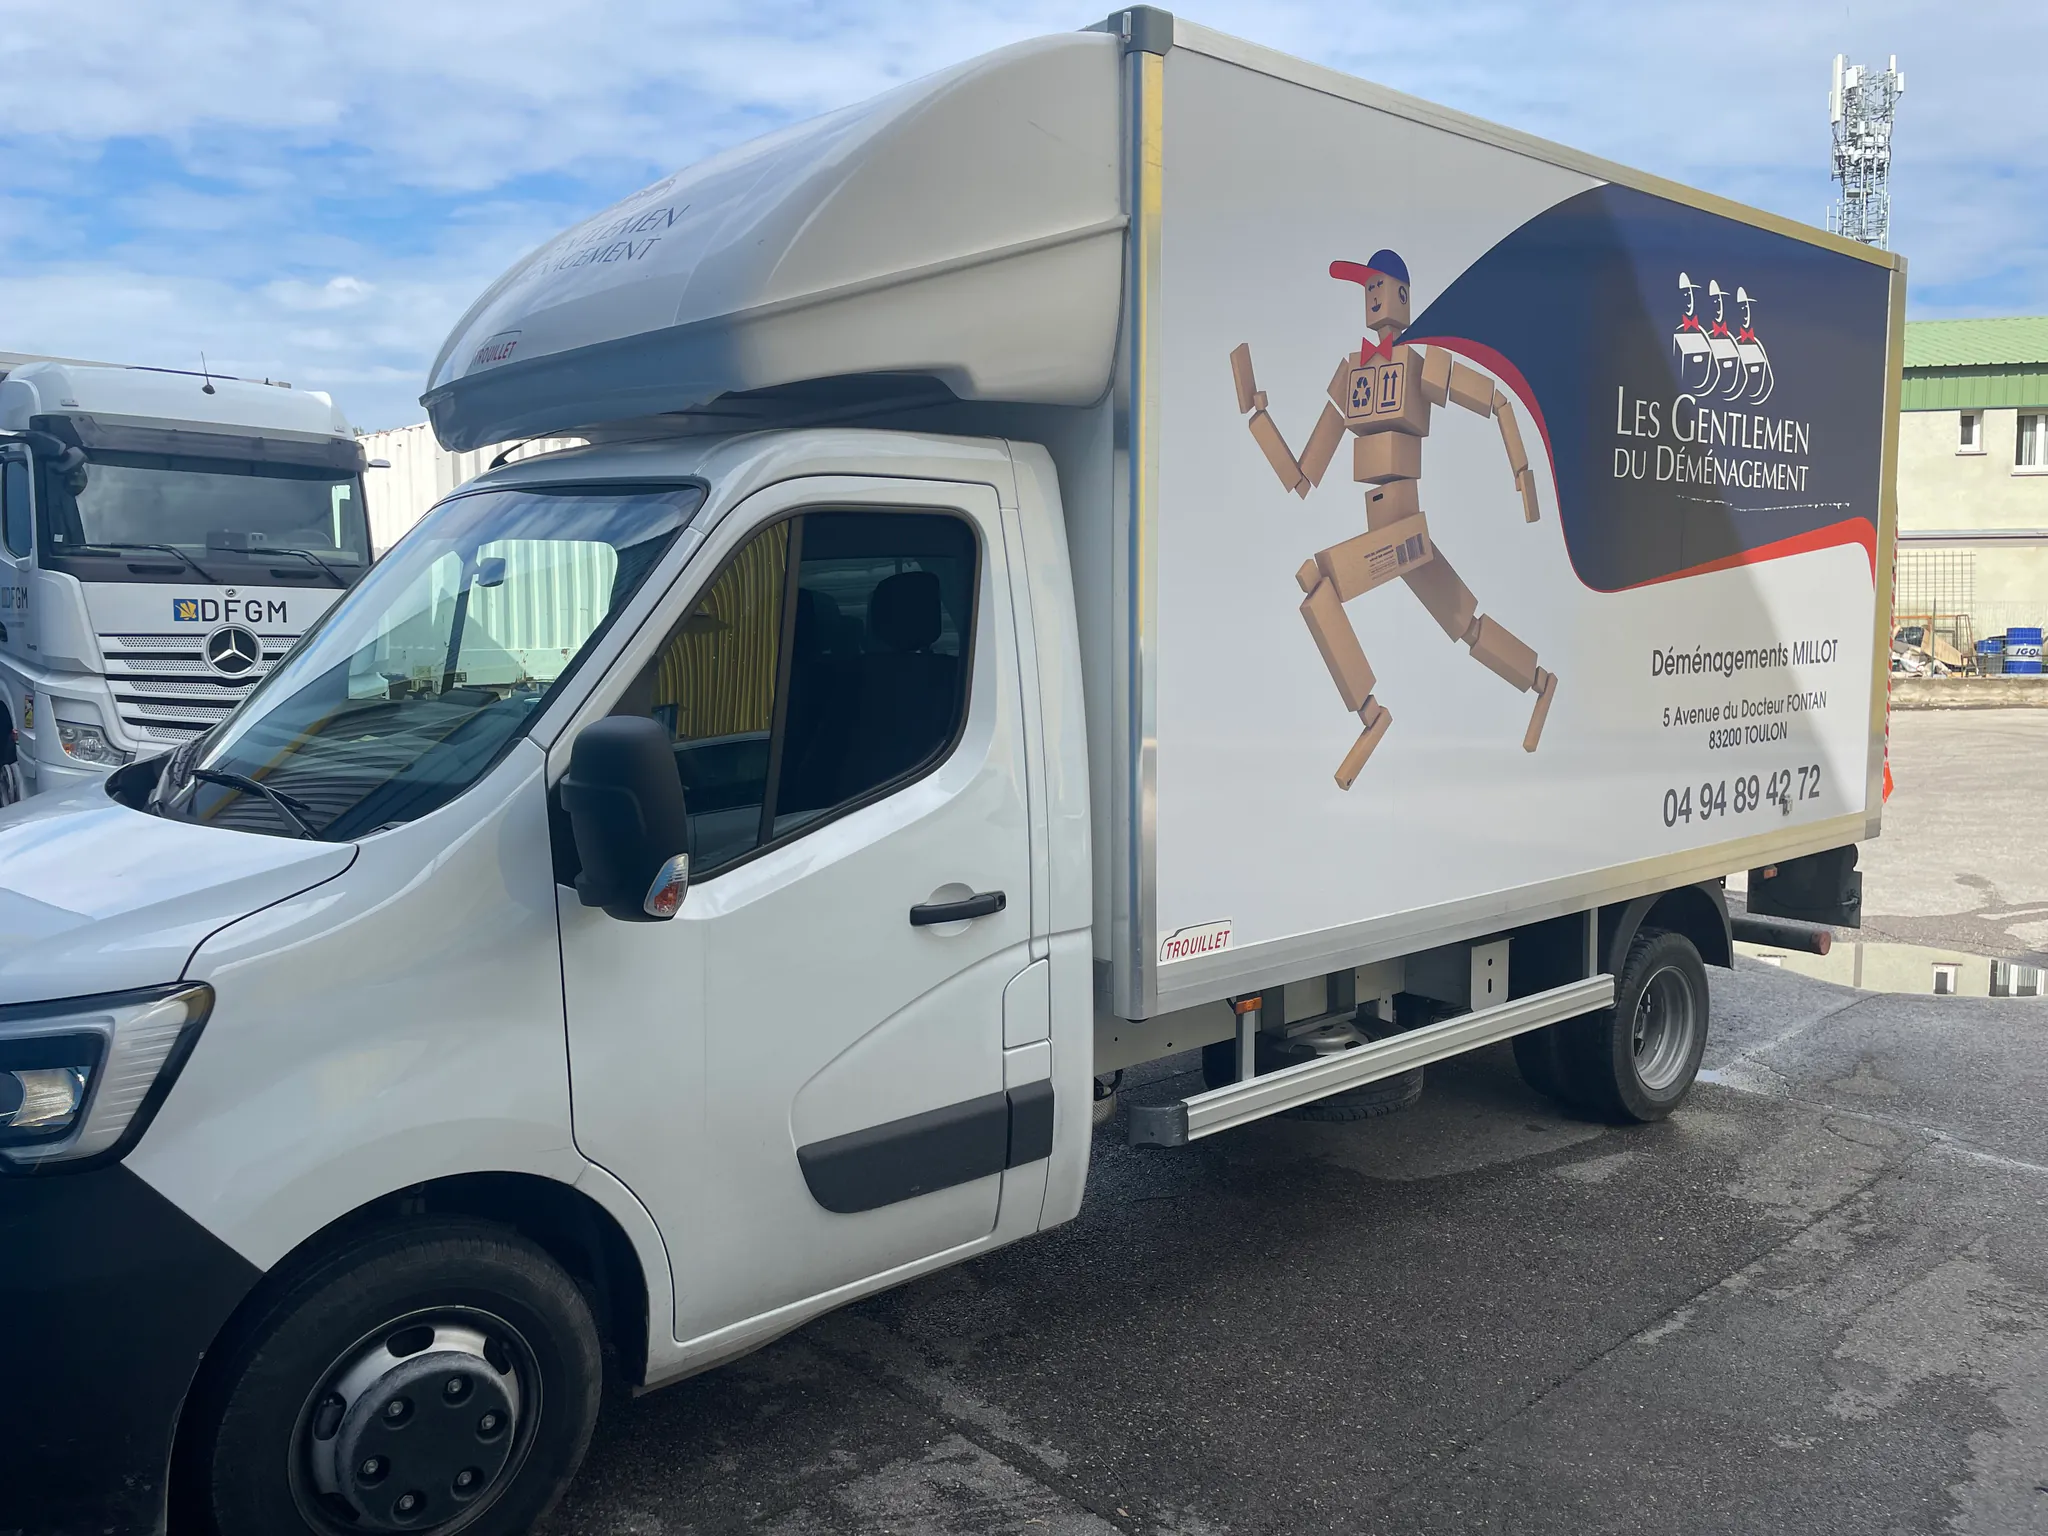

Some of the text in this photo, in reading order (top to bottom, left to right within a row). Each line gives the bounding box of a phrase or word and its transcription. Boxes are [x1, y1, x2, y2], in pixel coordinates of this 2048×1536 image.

[200, 598, 288, 623] DFGM
[1651, 638, 1838, 678] Déménagements MILLOT
[1662, 690, 1827, 728] 5 Avenue du Docteur FONTAN
[1708, 721, 1788, 750] 83200 TOULON
[1663, 764, 1821, 828] 04 94 89 42 72
[1166, 930, 1230, 958] TROUILLET
